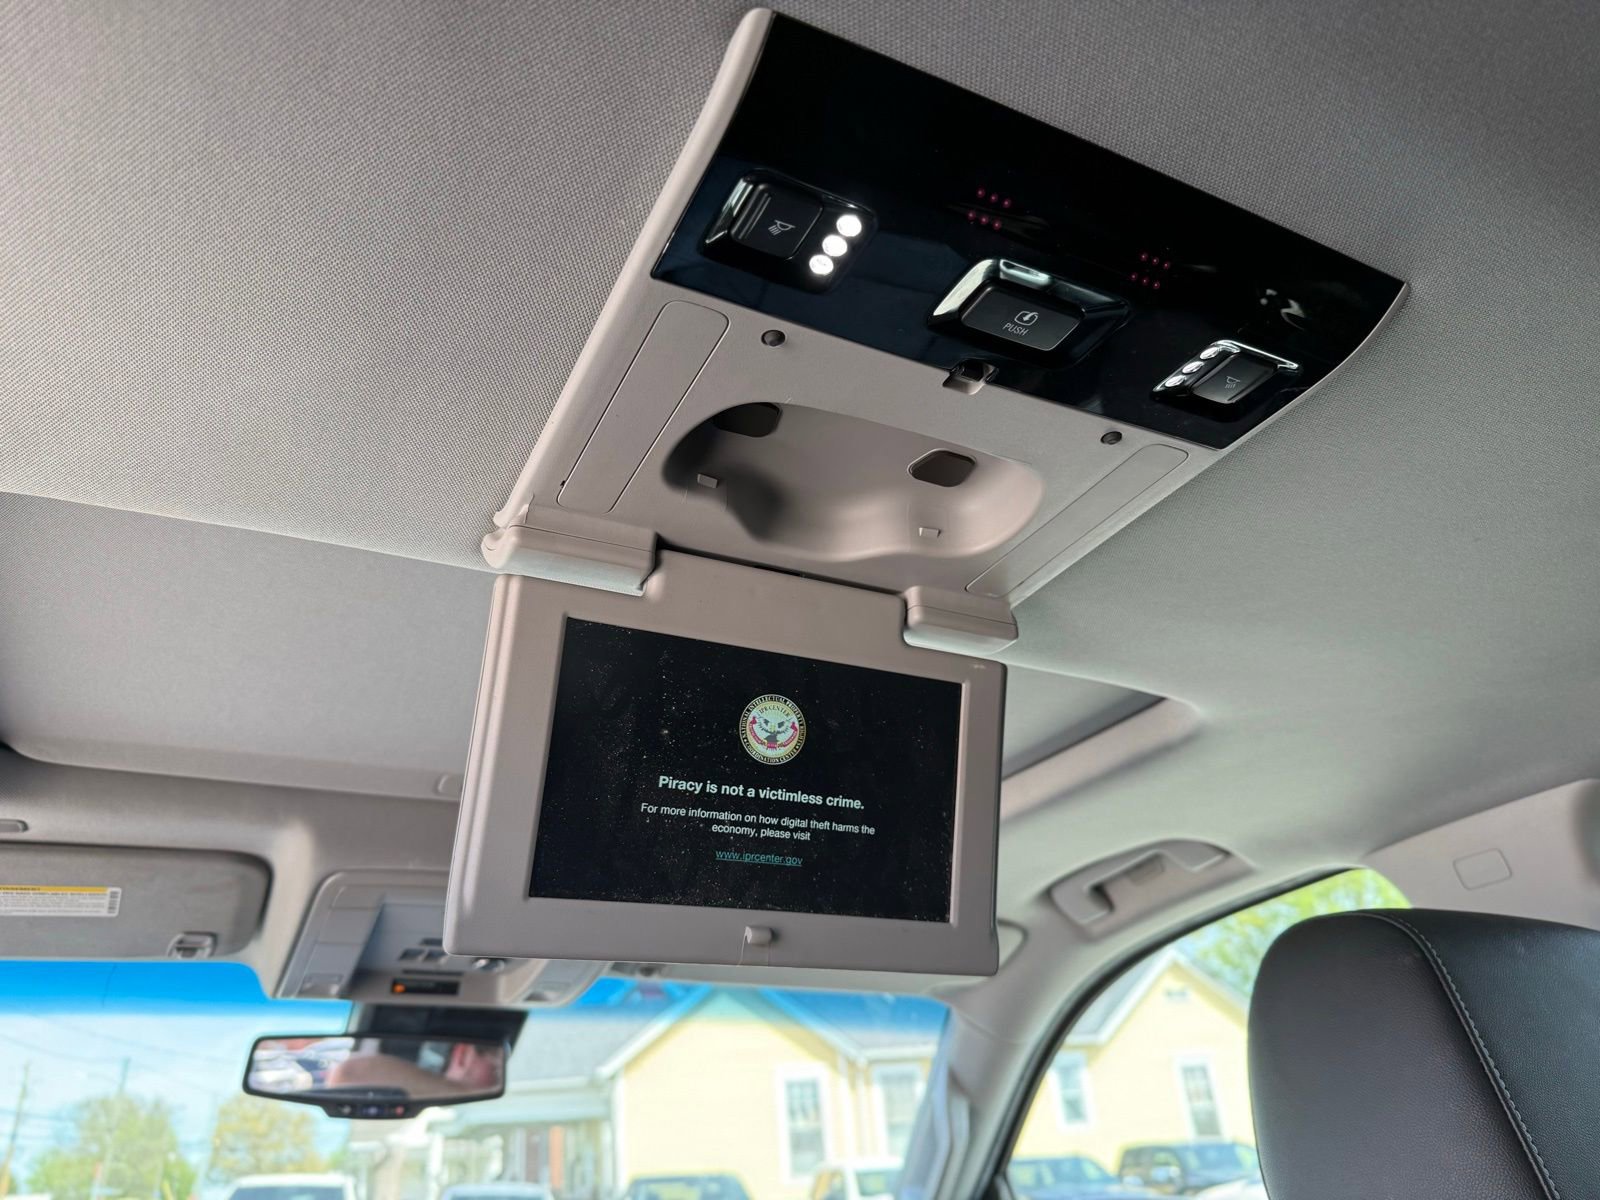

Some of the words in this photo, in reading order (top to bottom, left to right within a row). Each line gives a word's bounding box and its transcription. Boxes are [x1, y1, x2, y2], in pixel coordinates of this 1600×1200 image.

[1003, 322, 1029, 336] PUSH
[658, 775, 703, 795] Piracy
[706, 780, 718, 793] is
[721, 784, 744, 797] not
[746, 787, 756, 798] a
[759, 787, 823, 805] victimless
[826, 795, 865, 810] crime.
[640, 802, 658, 814] For
[660, 806, 686, 817] more
[688, 807, 742, 822] information
[744, 813, 756, 823] on
[759, 814, 778, 826] how
[781, 816, 808, 830] digital
[810, 819, 831, 831] theft
[832, 821, 860, 834] harms
[861, 824, 875, 835] the
[711, 823, 758, 838] economy,
[760, 827, 791, 840] please
[793, 829, 811, 841] visit
[715, 849, 803, 867] www.iprcenter.gov
